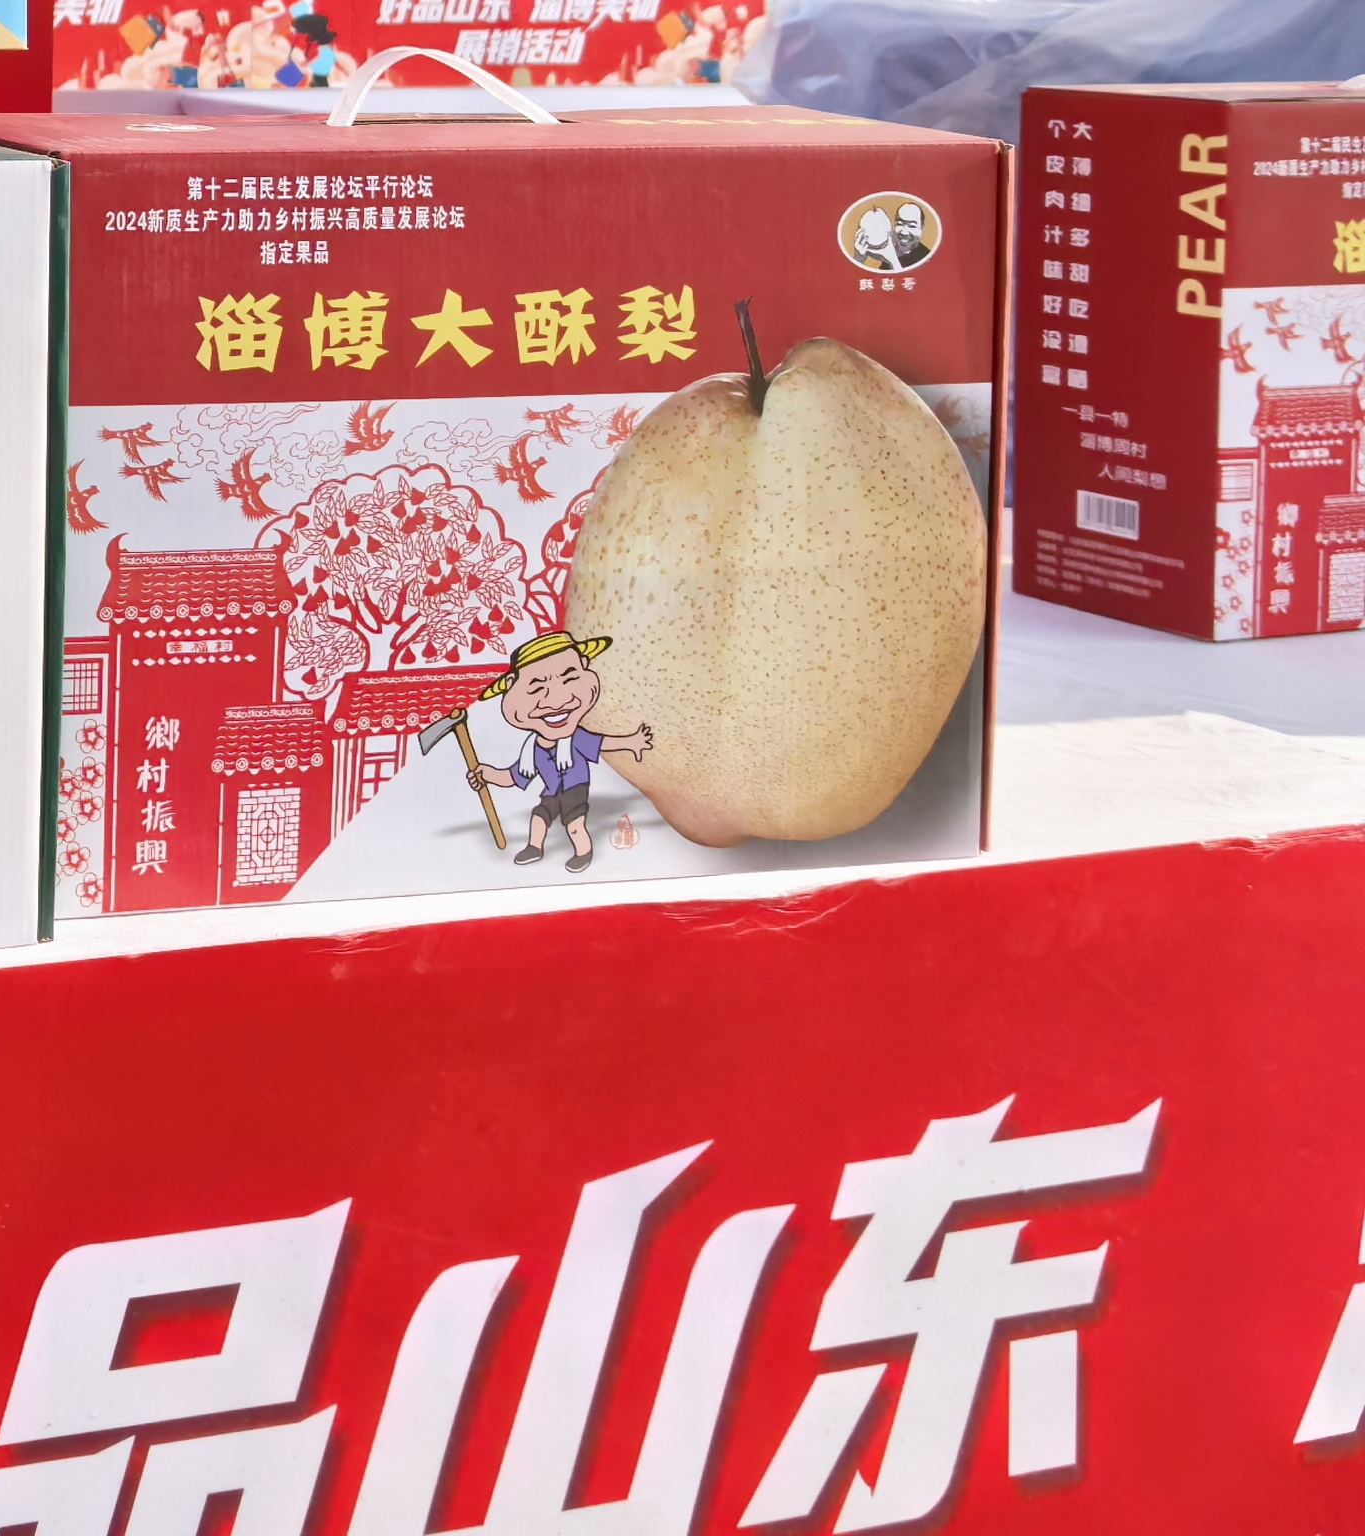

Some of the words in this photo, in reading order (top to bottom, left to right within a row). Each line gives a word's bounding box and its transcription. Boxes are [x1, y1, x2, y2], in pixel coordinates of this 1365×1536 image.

[453, 28, 587, 66] 展销活动
[1047, 119, 1093, 141] 个大
[186, 174, 434, 201] 第十二届民生发展论坛平行论坛
[1044, 190, 1091, 212] 肉细
[105, 205, 466, 233] 2024新质生产力助力乡村振兴高质量发展论坛
[1177, 132, 1229, 320] PEAR
[1043, 225, 1090, 248] 汁多
[260, 240, 330, 265] 指定果品
[1042, 294, 1089, 319] 好吃
[194, 283, 698, 373] 淄博大酥梨
[168, 640, 233, 653] 幸福村
[131, 715, 180, 876] 鄉村振興
